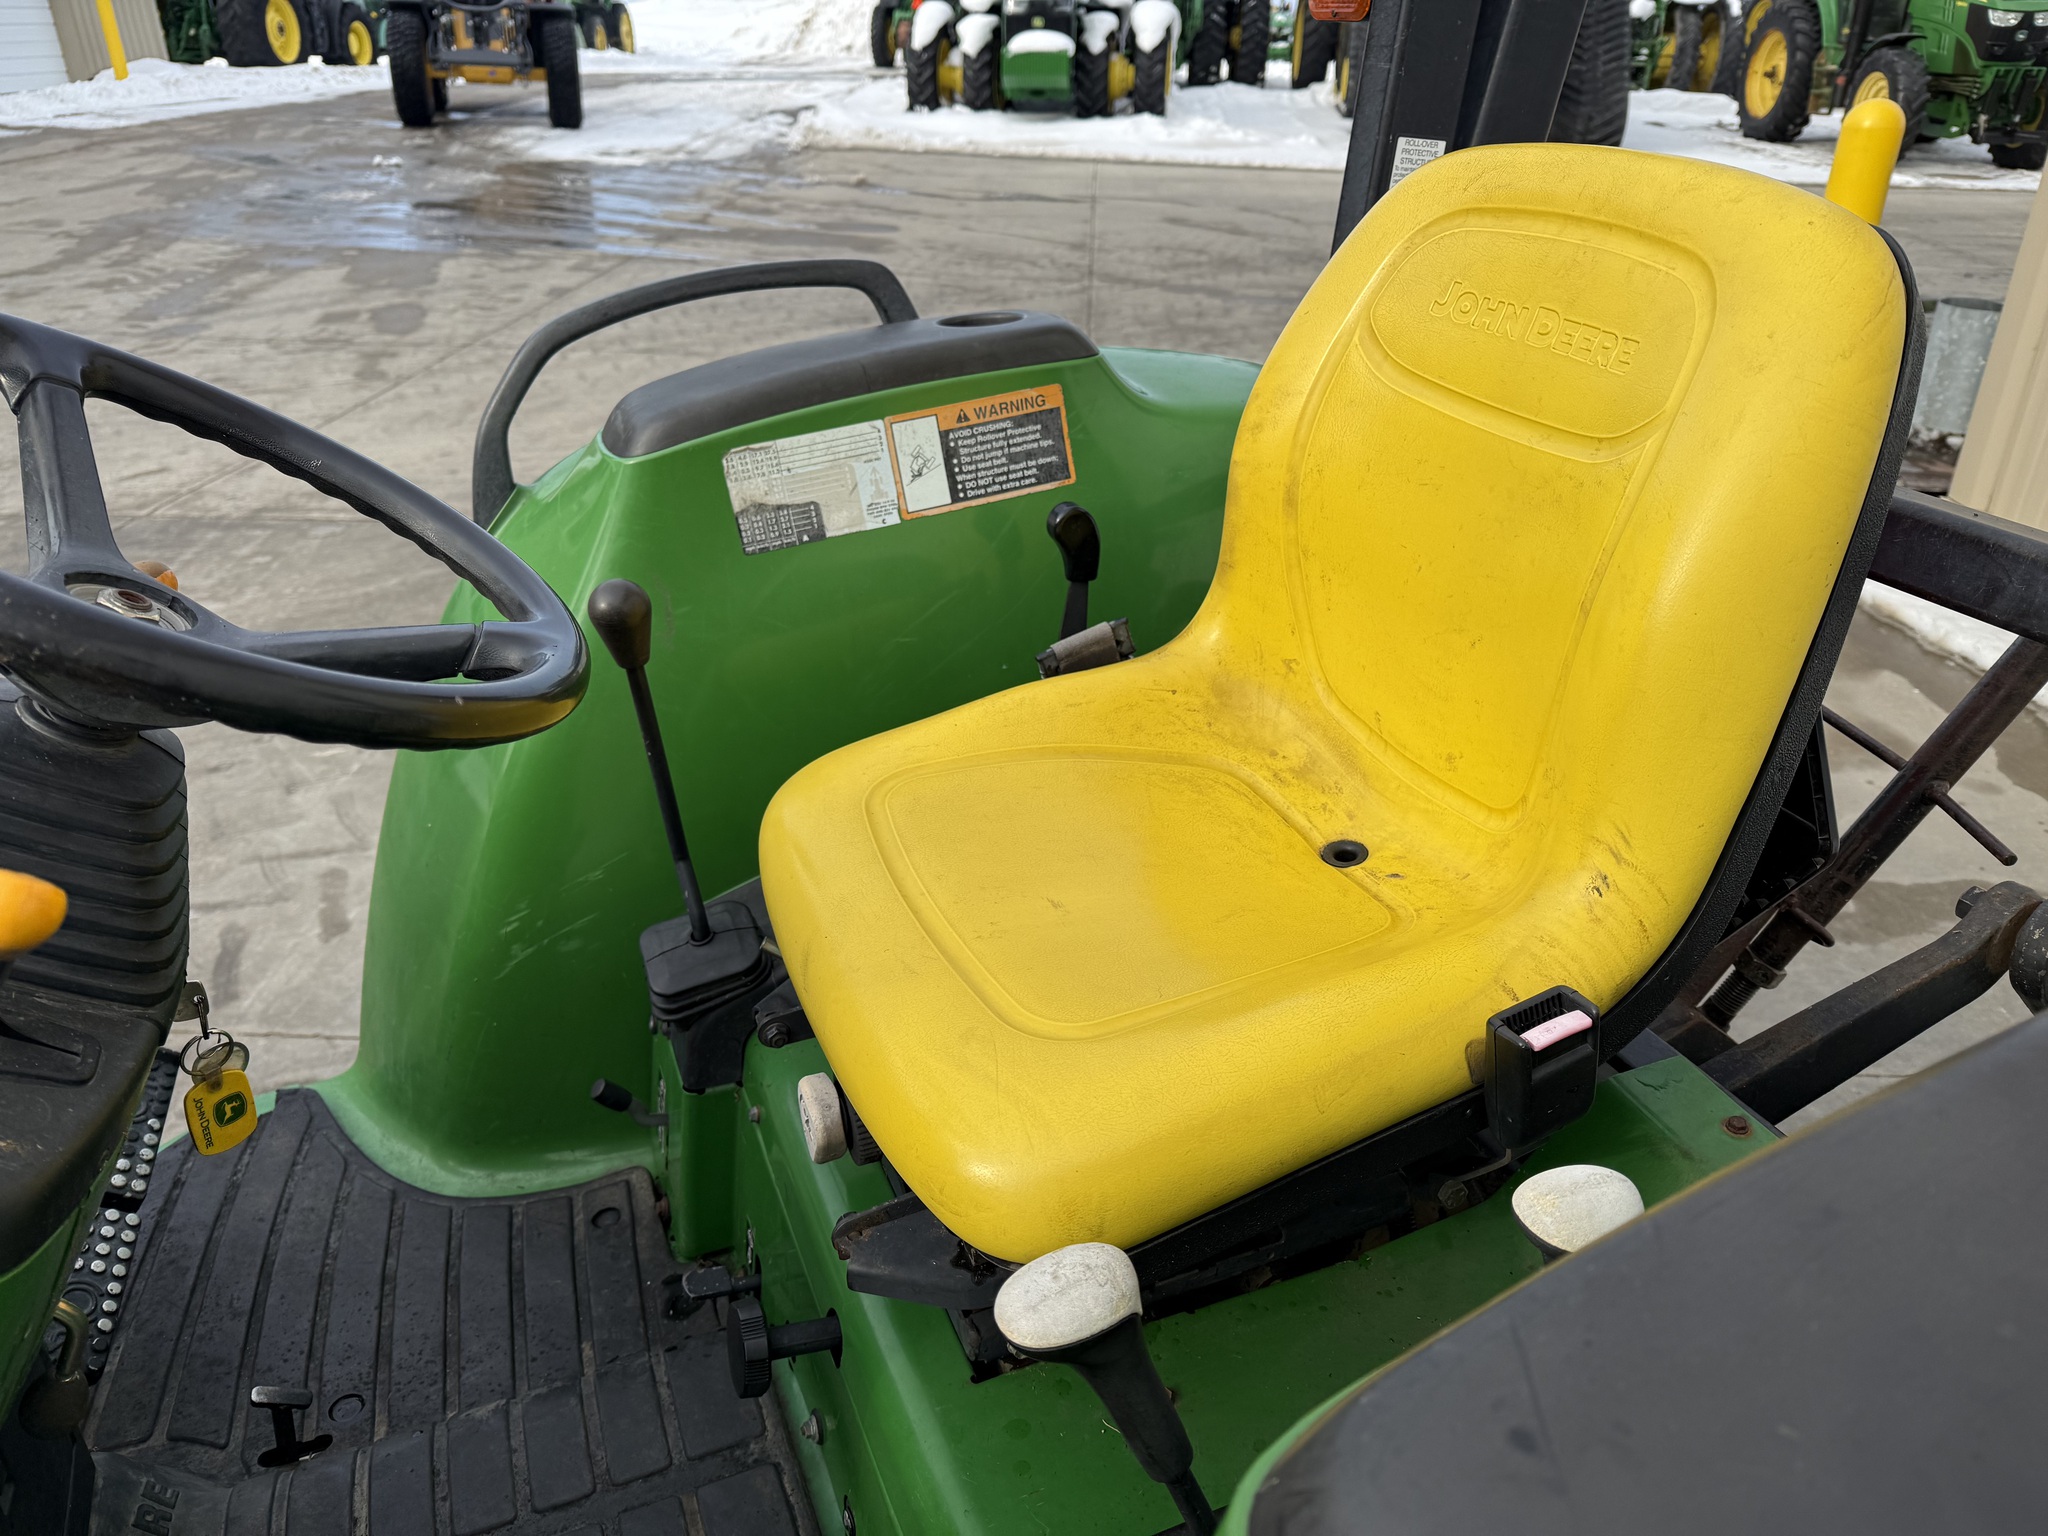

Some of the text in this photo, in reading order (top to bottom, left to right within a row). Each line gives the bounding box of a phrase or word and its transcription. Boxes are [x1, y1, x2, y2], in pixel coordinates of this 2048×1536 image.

[1401, 148, 1439, 157] PROTECTIVE
[1405, 139, 1439, 149] ROLL-OVER
[1429, 280, 1641, 376] JOHN DEERE
[973, 395, 1046, 420] WARNING
[948, 420, 1014, 440] AVOID CRUSHING:
[958, 424, 1042, 448] Keep Rollover Protective
[959, 433, 1042, 455] Structure fully extended.
[961, 439, 1055, 464] Do not jump if machine tips.
[955, 472, 977, 483] When
[977, 467, 1009, 478] structure
[1009, 462, 1027, 472] must
[1027, 459, 1037, 467] be
[962, 457, 1009, 473] Use seat belt.
[965, 468, 1040, 489] DO NOT use seat belt.
[967, 478, 1038, 498] Drive with extra care.
[803, 534, 810, 542] A
[194, 1098, 213, 1149] JOHN DEERE
